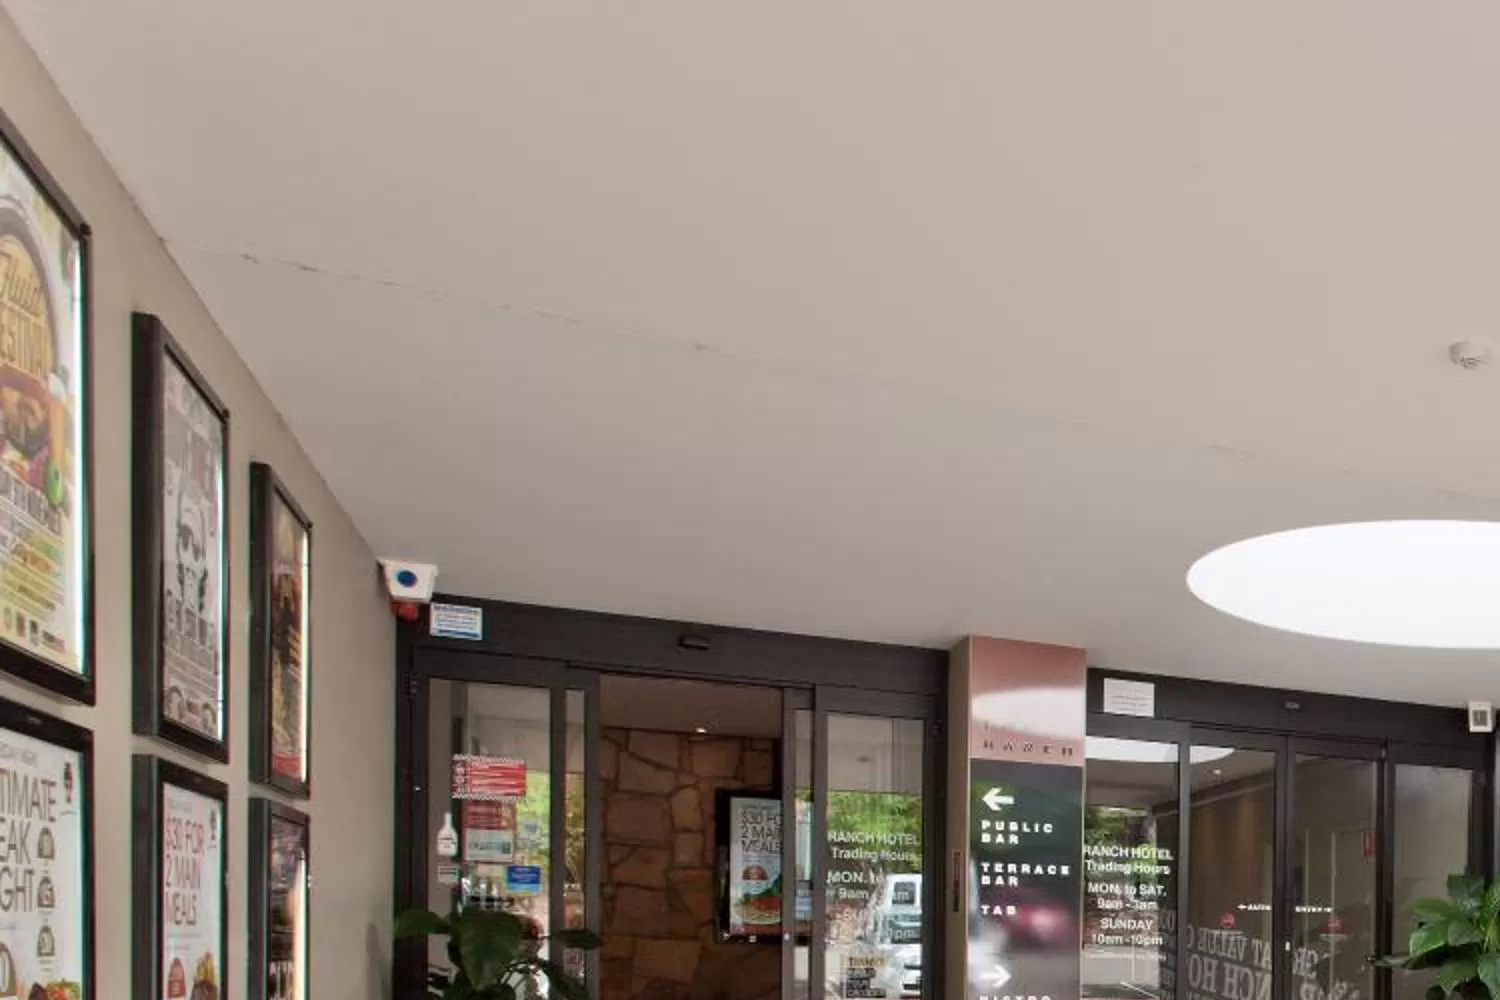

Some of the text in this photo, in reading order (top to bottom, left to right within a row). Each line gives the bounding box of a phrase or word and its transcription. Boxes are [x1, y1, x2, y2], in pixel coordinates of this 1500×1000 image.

[981, 819, 1054, 834] PUBLIC
[981, 832, 1019, 845] BAR
[832, 848, 878, 861] Trading
[1131, 846, 1174, 861] HOTEL
[981, 862, 1070, 876] TERRACE
[1086, 860, 1171, 875] Trading Hours
[981, 875, 1019, 887] BAR
[981, 905, 1016, 916] TAB
[1100, 917, 1154, 931] SUNDAY
